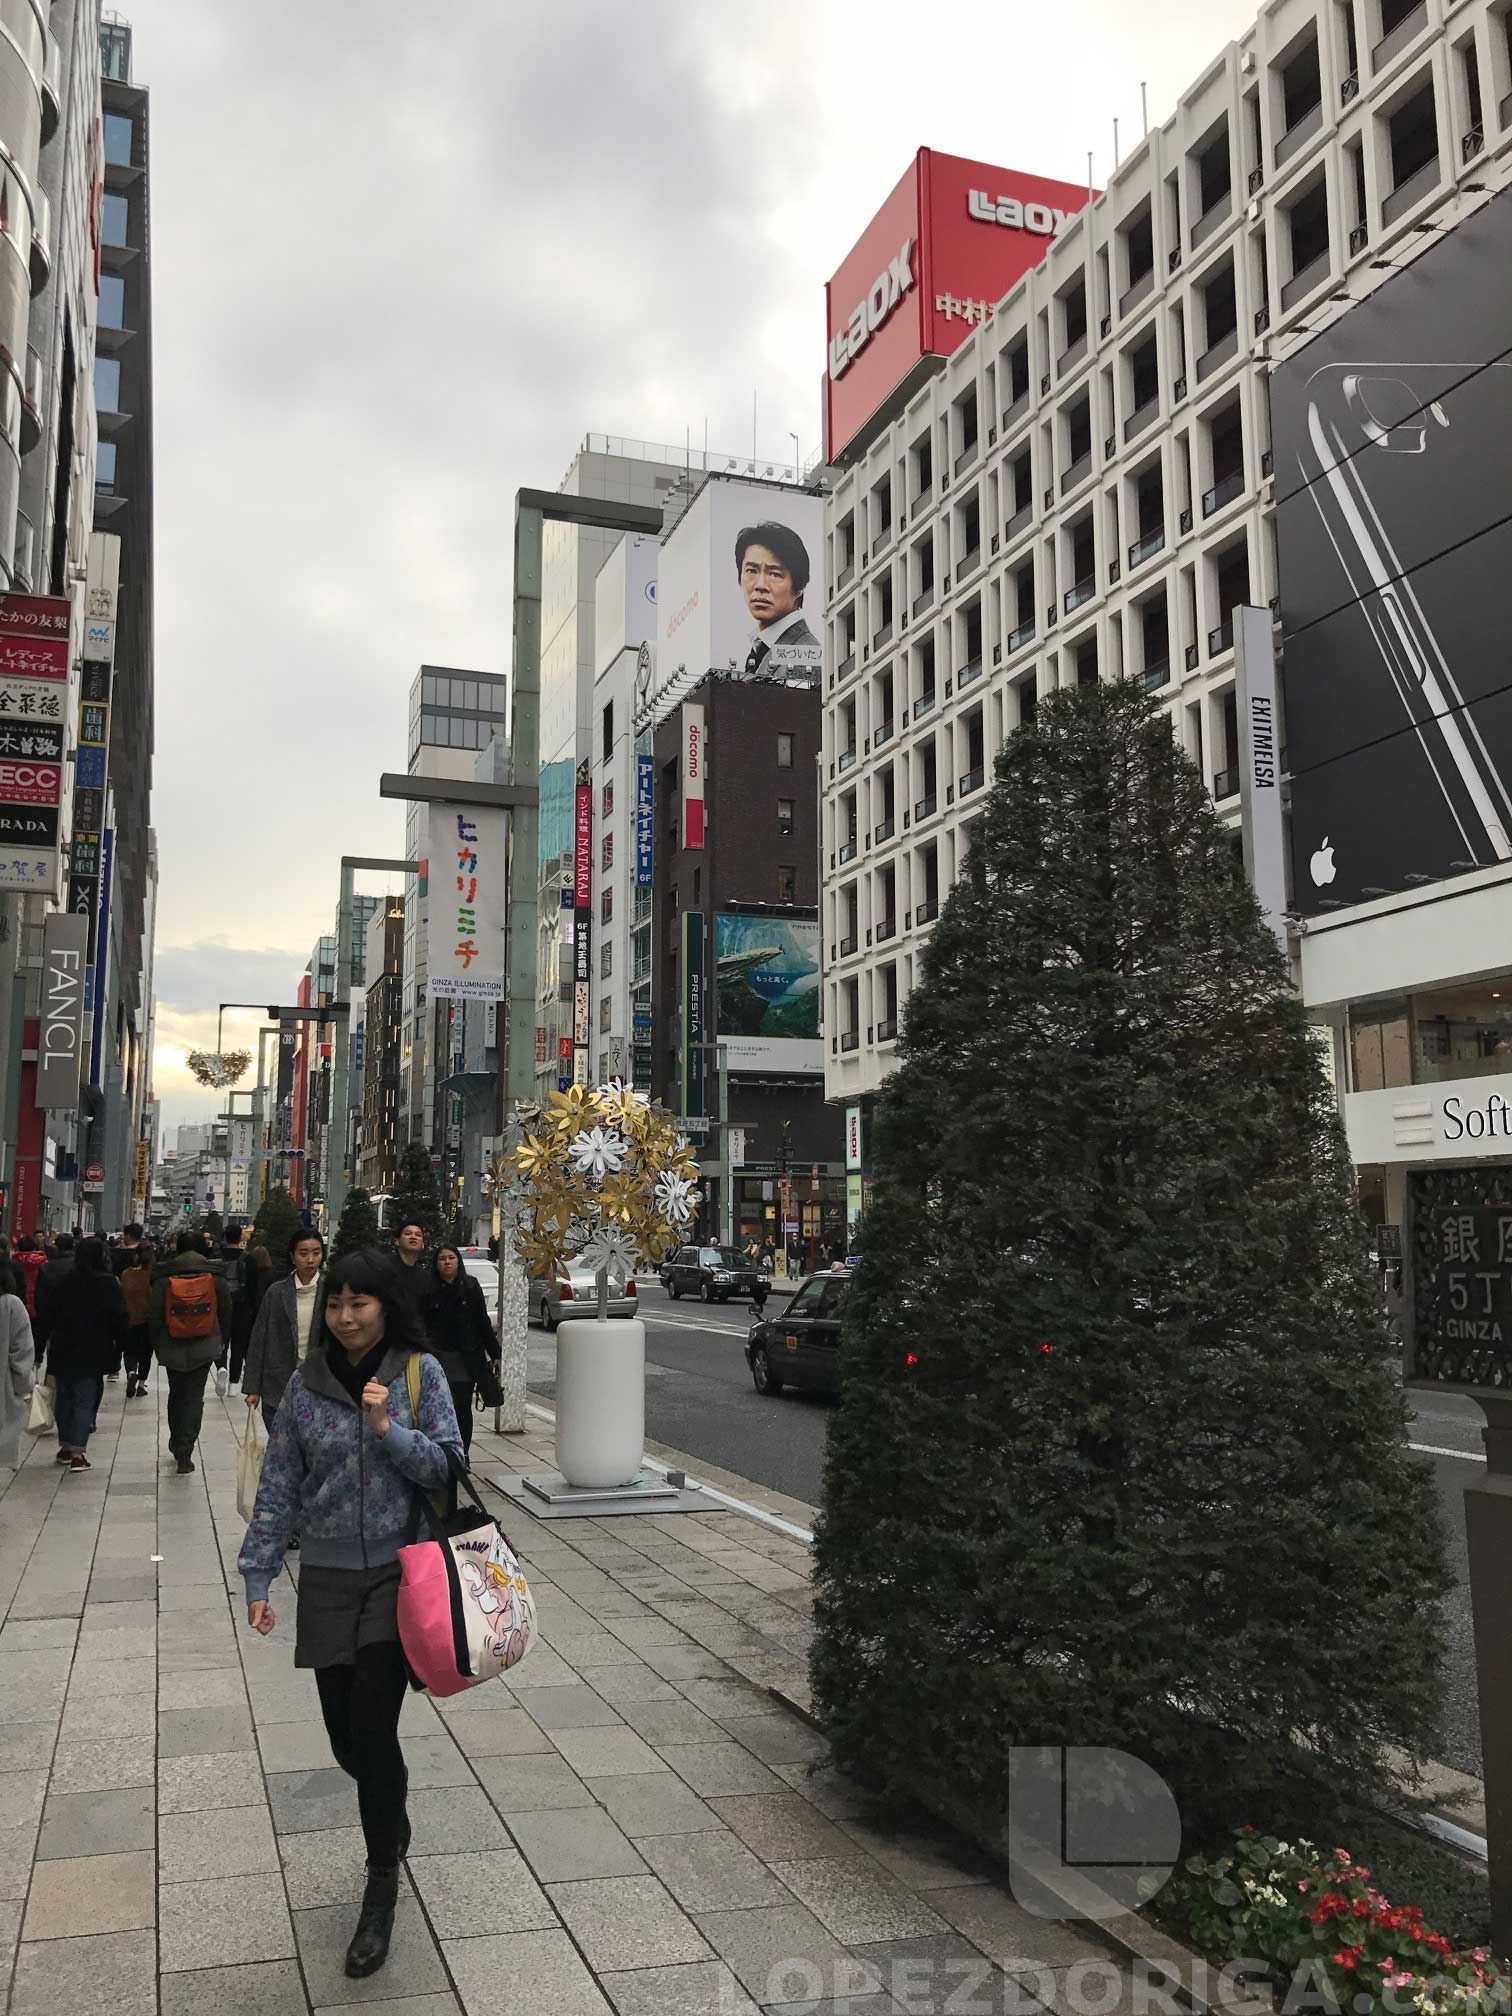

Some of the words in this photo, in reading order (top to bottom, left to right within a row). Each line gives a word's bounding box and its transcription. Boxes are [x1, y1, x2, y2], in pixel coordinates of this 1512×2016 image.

[6, 648, 54, 662] レディース
[689, 725, 701, 778] docomo
[1251, 696, 1275, 789] EXITMELSA
[0, 765, 57, 788] ECC
[639, 763, 653, 868] アートネイチャー
[577, 837, 589, 898] NATARAJ
[639, 874, 652, 882] 6F
[455, 814, 479, 969] ヒカリミチ
[431, 978, 452, 986] GINZA
[454, 980, 502, 990] ILLUMINATION
[755, 975, 789, 984] もっと高く。
[44, 949, 80, 1071] FANCL
[1443, 1094, 1512, 1141] Soft
[1449, 1272, 1512, 1314] 5丁
[1446, 1318, 1503, 1342] GINZA
